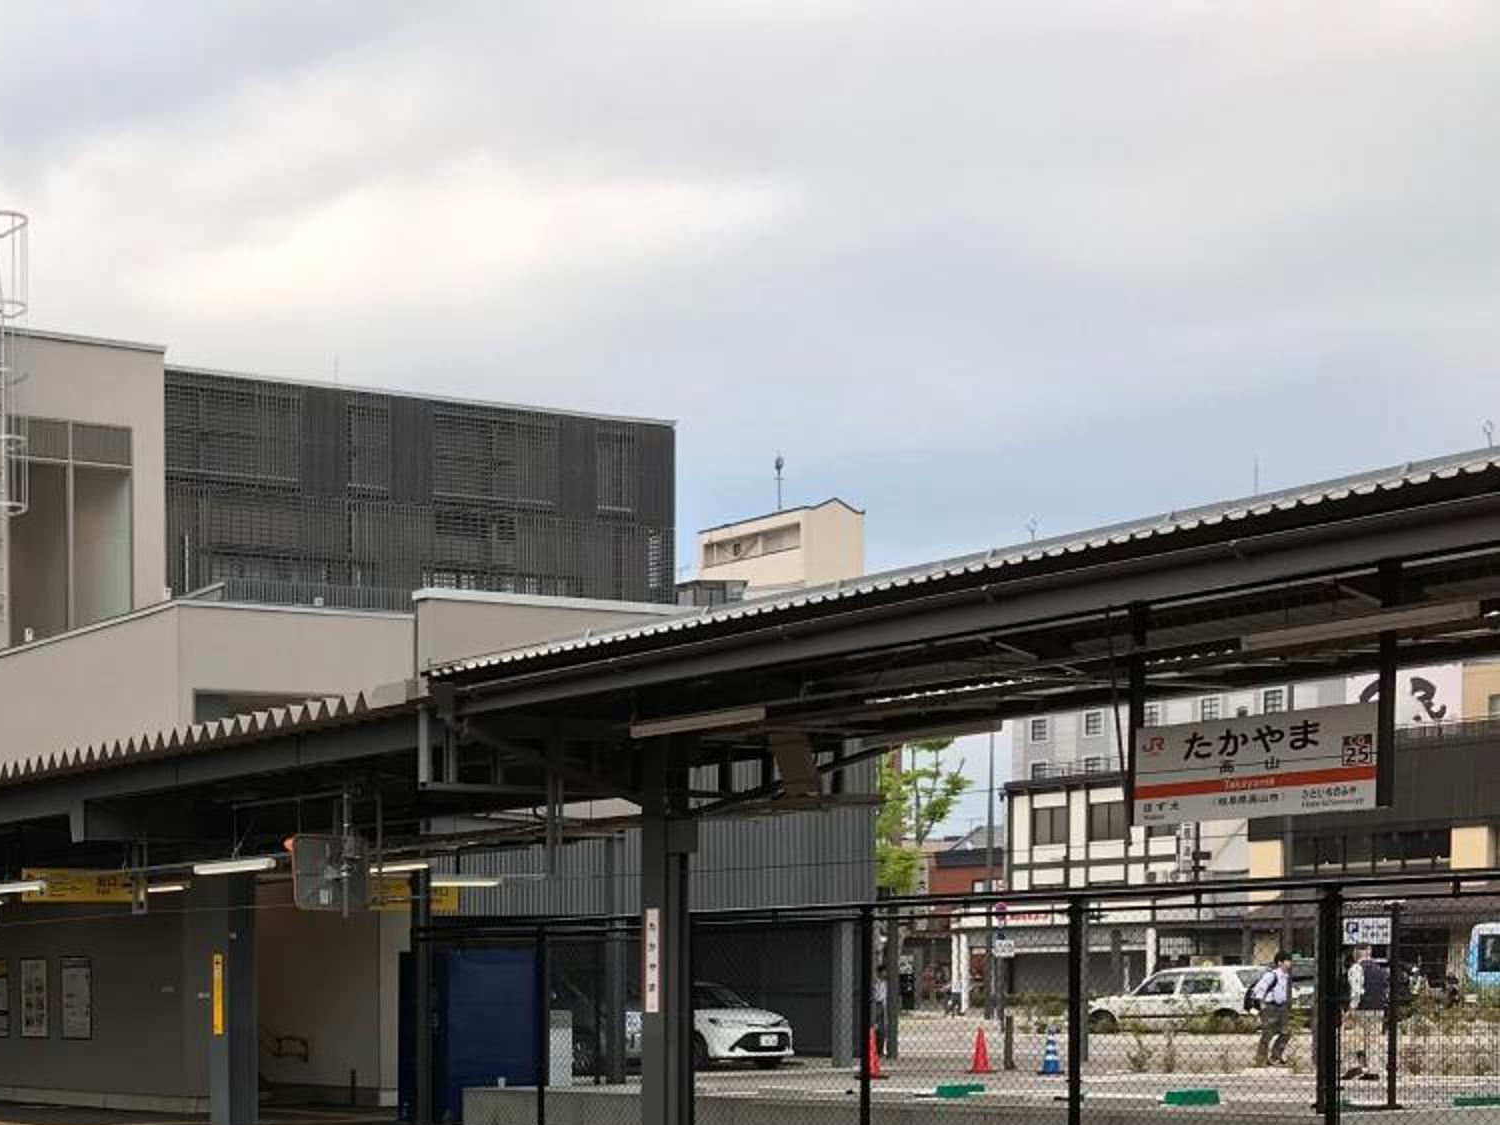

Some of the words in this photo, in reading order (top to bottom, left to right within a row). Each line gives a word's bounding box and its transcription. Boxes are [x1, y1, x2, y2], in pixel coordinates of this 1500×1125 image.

[1142, 737, 1165, 753] JR
[1183, 719, 1320, 761] たかやま
[1346, 745, 1369, 764] 25
